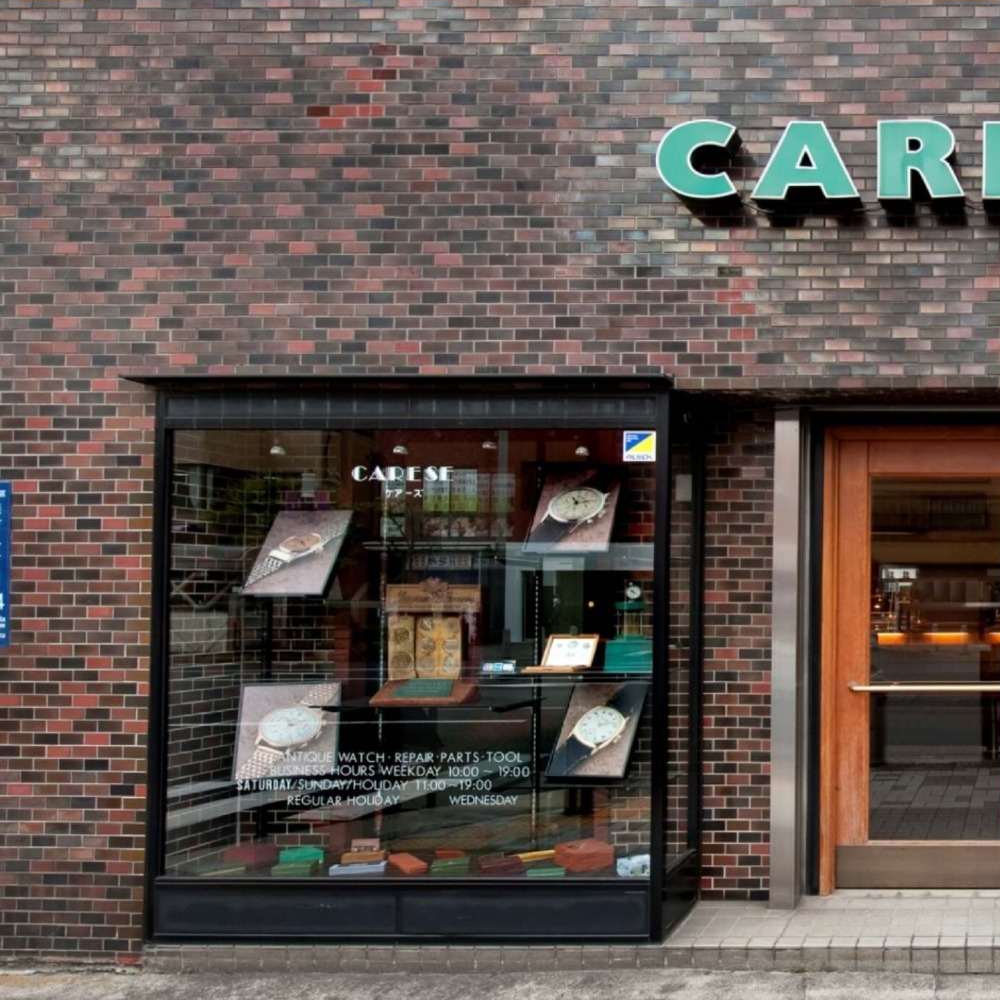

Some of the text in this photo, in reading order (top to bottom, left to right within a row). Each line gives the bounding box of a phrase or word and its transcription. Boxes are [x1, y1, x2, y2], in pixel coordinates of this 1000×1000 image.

[351, 465, 454, 482] CARESE
[280, 752, 333, 763] ANTIQUE
[338, 752, 385, 763] WATCH
[270, 765, 326, 776] BUSINESS
[331, 765, 376, 777] HOURS
[380, 765, 441, 777] WEEKDAY
[448, 766, 479, 777] 10:00
[499, 766, 530, 778] 19:00
[287, 795, 518, 806] REGULAR HOLIDAY WEDNESDAY
